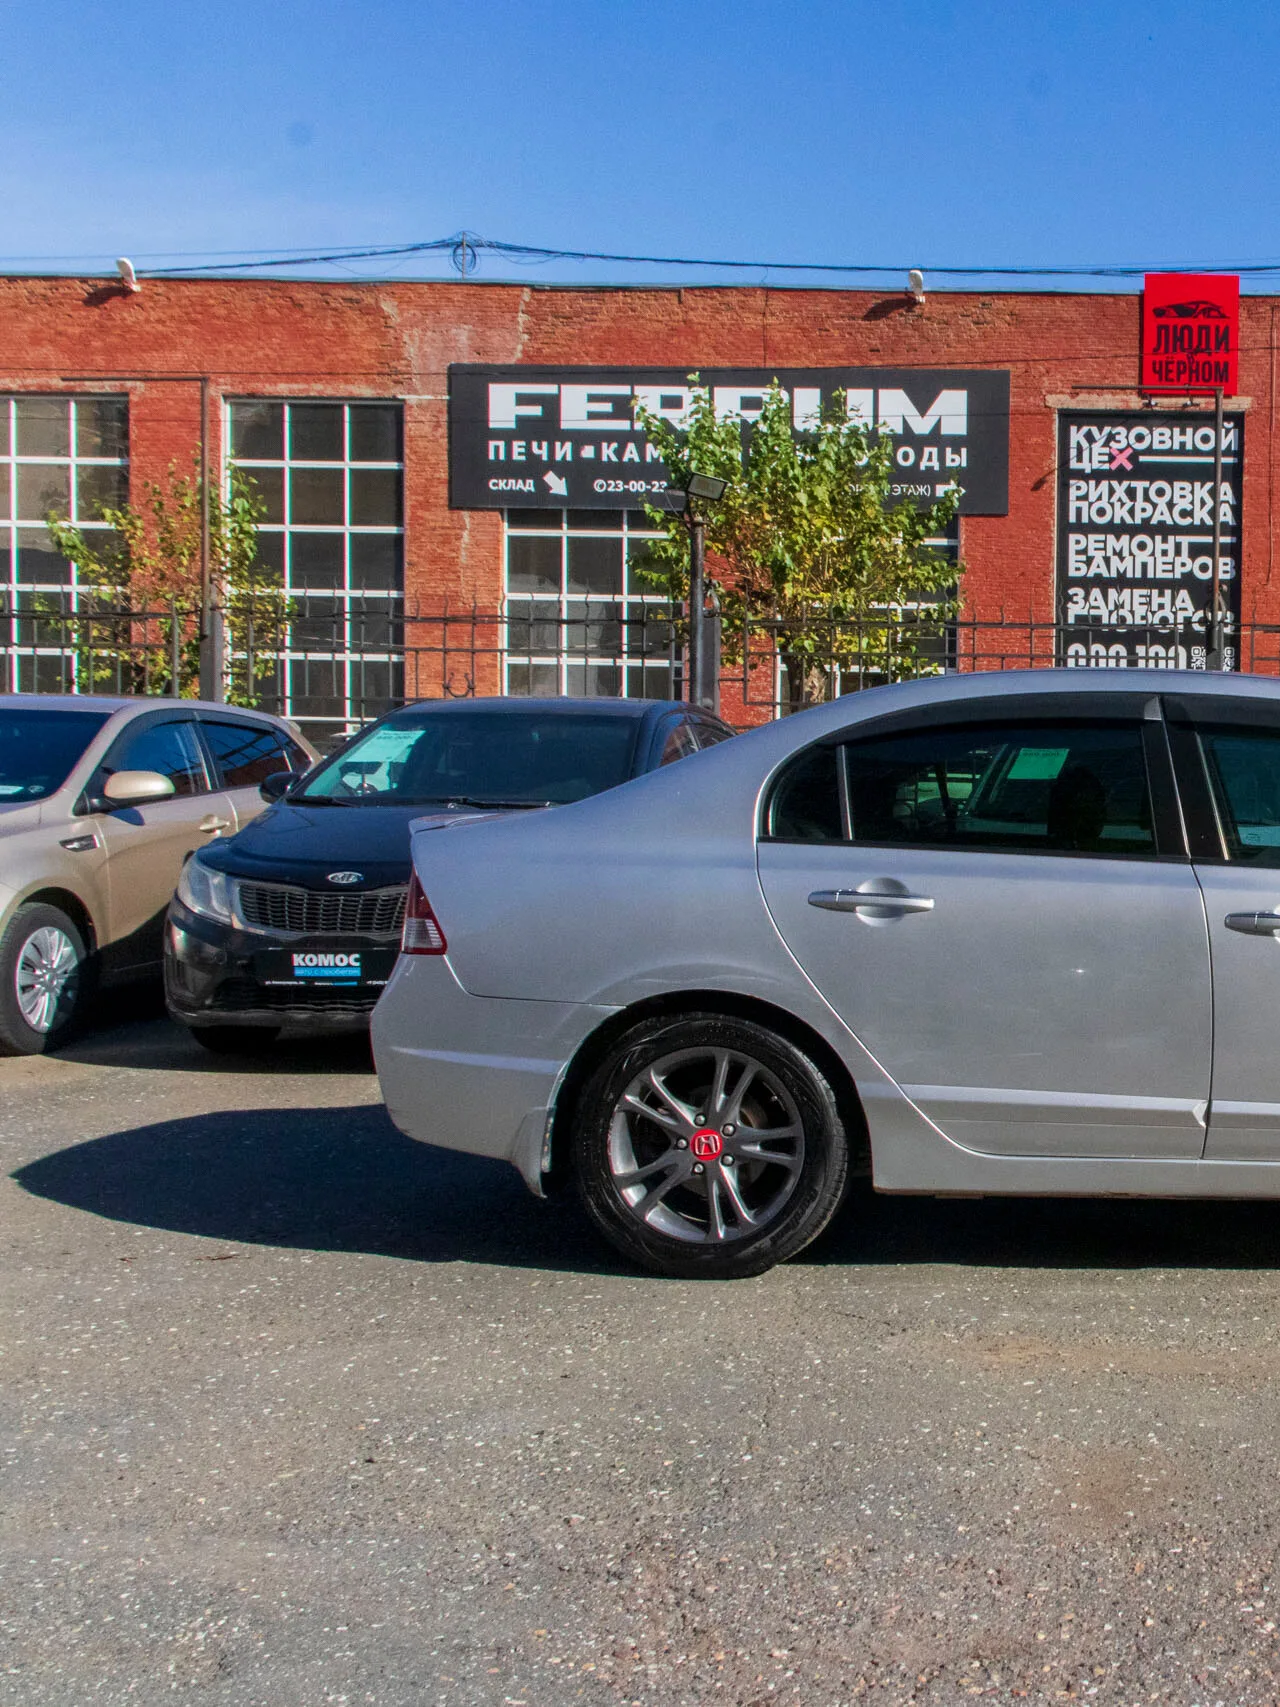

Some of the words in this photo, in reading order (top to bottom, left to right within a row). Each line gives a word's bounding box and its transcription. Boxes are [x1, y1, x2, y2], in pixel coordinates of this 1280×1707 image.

[1153, 324, 1229, 355] ЛЮДИ
[1152, 356, 1229, 383] ЧЁРНОМ
[488, 383, 967, 436] FERRUM
[1070, 421, 1238, 452] КУЗОВНОЙ
[488, 440, 572, 461] ПЕЧИ
[1069, 446, 1134, 474] ЦЕХ
[488, 479, 536, 493] СКЛАД
[1069, 479, 1237, 505] РИХТОВКА
[1068, 501, 1237, 526] ПОКРАСКА
[1068, 533, 1236, 559] РЕМОНТ
[1068, 555, 1236, 580] БАМПЕРОВ
[1066, 587, 1195, 612] ЗАМЕНА
